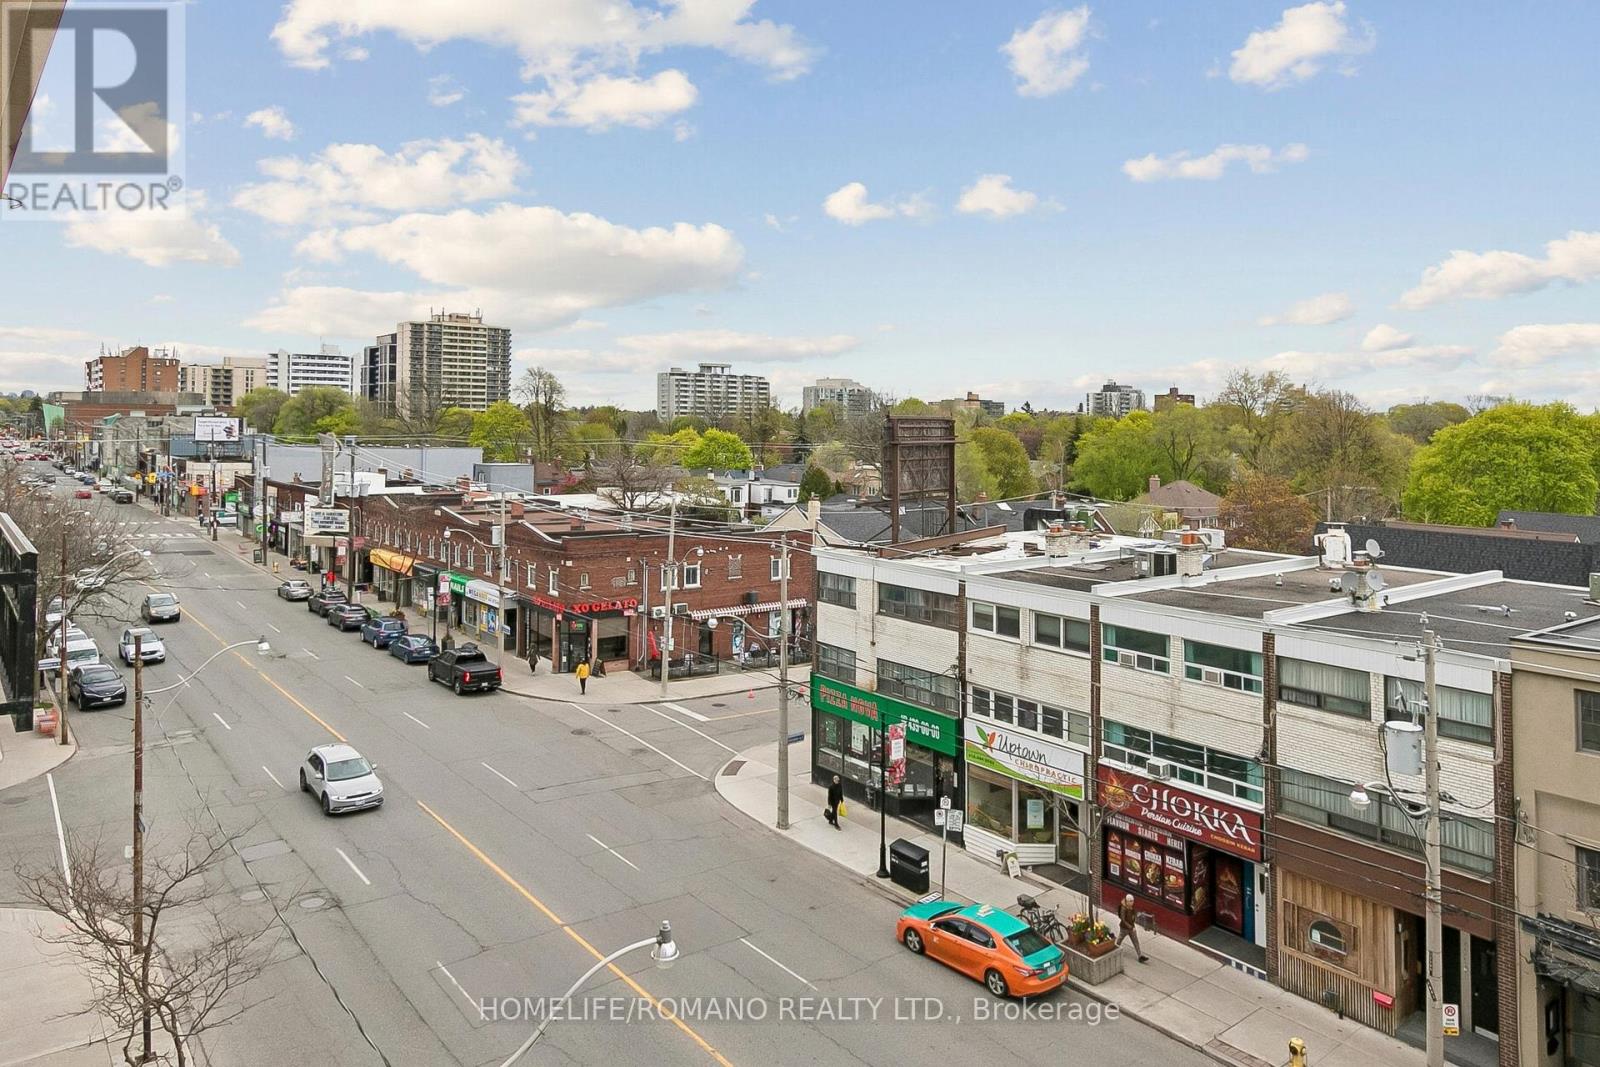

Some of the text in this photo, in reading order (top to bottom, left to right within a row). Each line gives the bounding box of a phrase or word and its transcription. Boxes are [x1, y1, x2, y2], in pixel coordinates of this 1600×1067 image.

[572, 602, 589, 613] XO
[591, 598, 638, 612] GELATO
[997, 733, 1048, 765] Uptown
[1014, 759, 1077, 783] CHIROPRACTIC
[1132, 783, 1255, 845] CHOKKA
[1141, 807, 1172, 827] Persian
[1172, 818, 1203, 836] Cuisine
